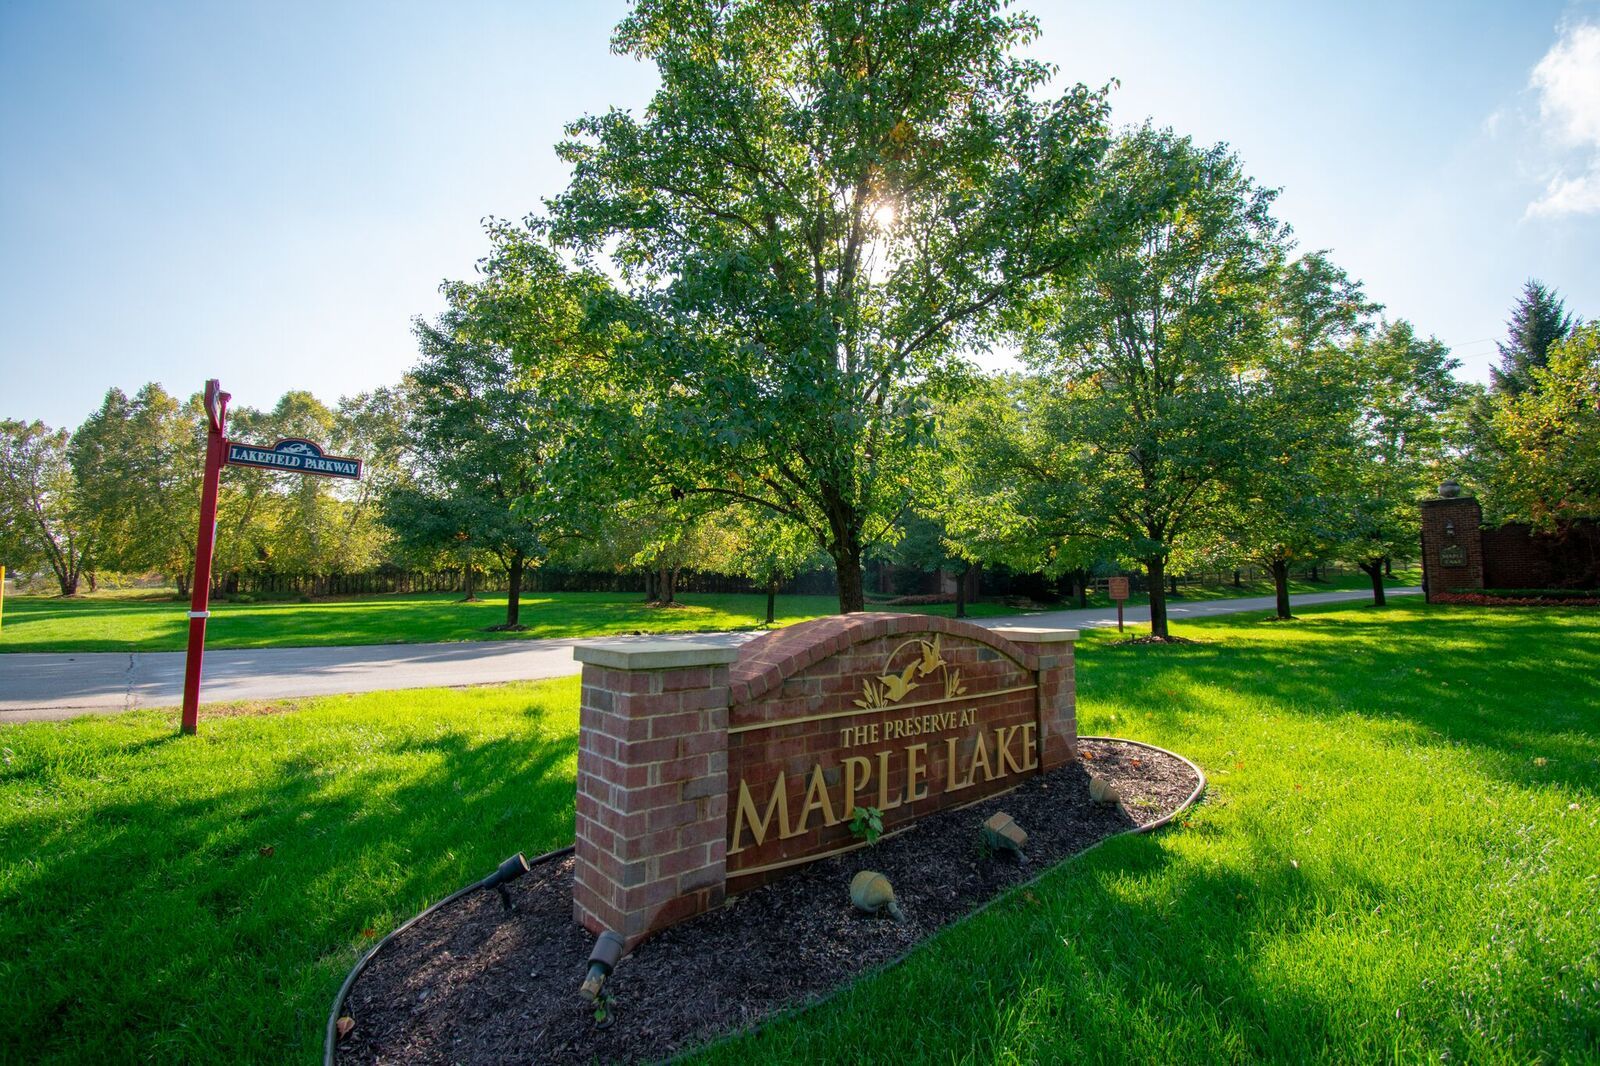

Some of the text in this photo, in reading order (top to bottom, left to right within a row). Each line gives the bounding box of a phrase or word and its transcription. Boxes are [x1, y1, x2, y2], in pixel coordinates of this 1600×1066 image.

[231, 448, 357, 474] LAKEFIELD PARKWAY
[841, 708, 978, 748] THE PRESERVE AT
[725, 722, 1038, 856] MAPLE LAKE
